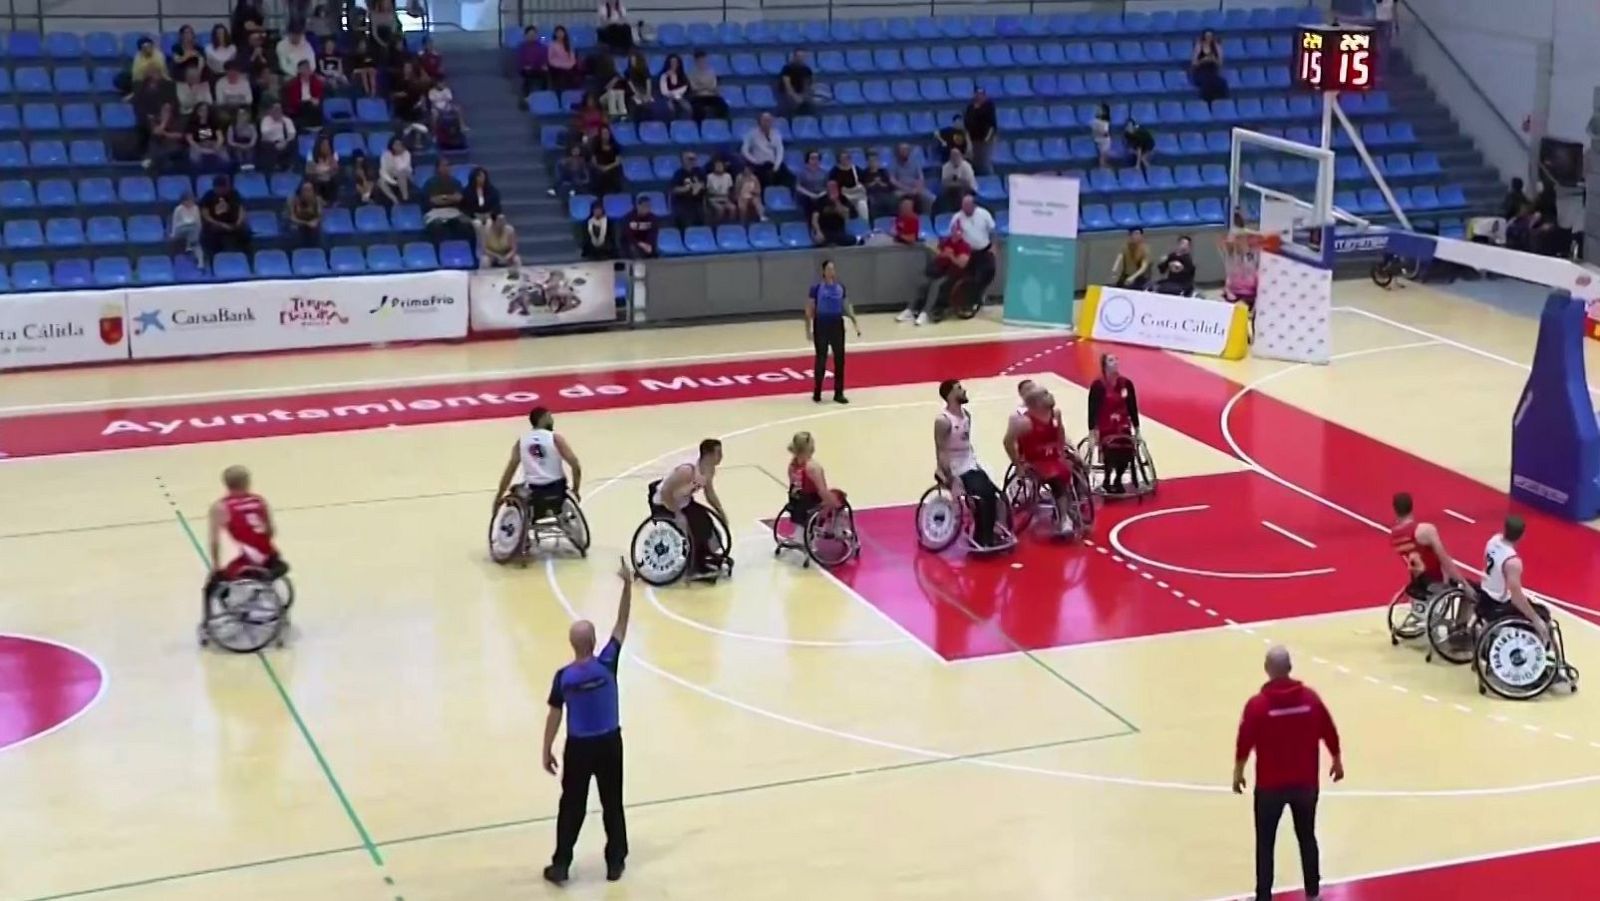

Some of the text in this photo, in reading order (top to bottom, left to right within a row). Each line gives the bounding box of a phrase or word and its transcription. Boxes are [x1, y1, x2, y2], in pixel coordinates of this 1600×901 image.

[1302, 51, 1322, 83] 15
[1339, 51, 1369, 85] 15
[171, 308, 256, 325] CaixaBank
[1140, 313, 1178, 330] Costa
[101, 392, 540, 435] Ayuntamiento
[558, 383, 629, 399] de
